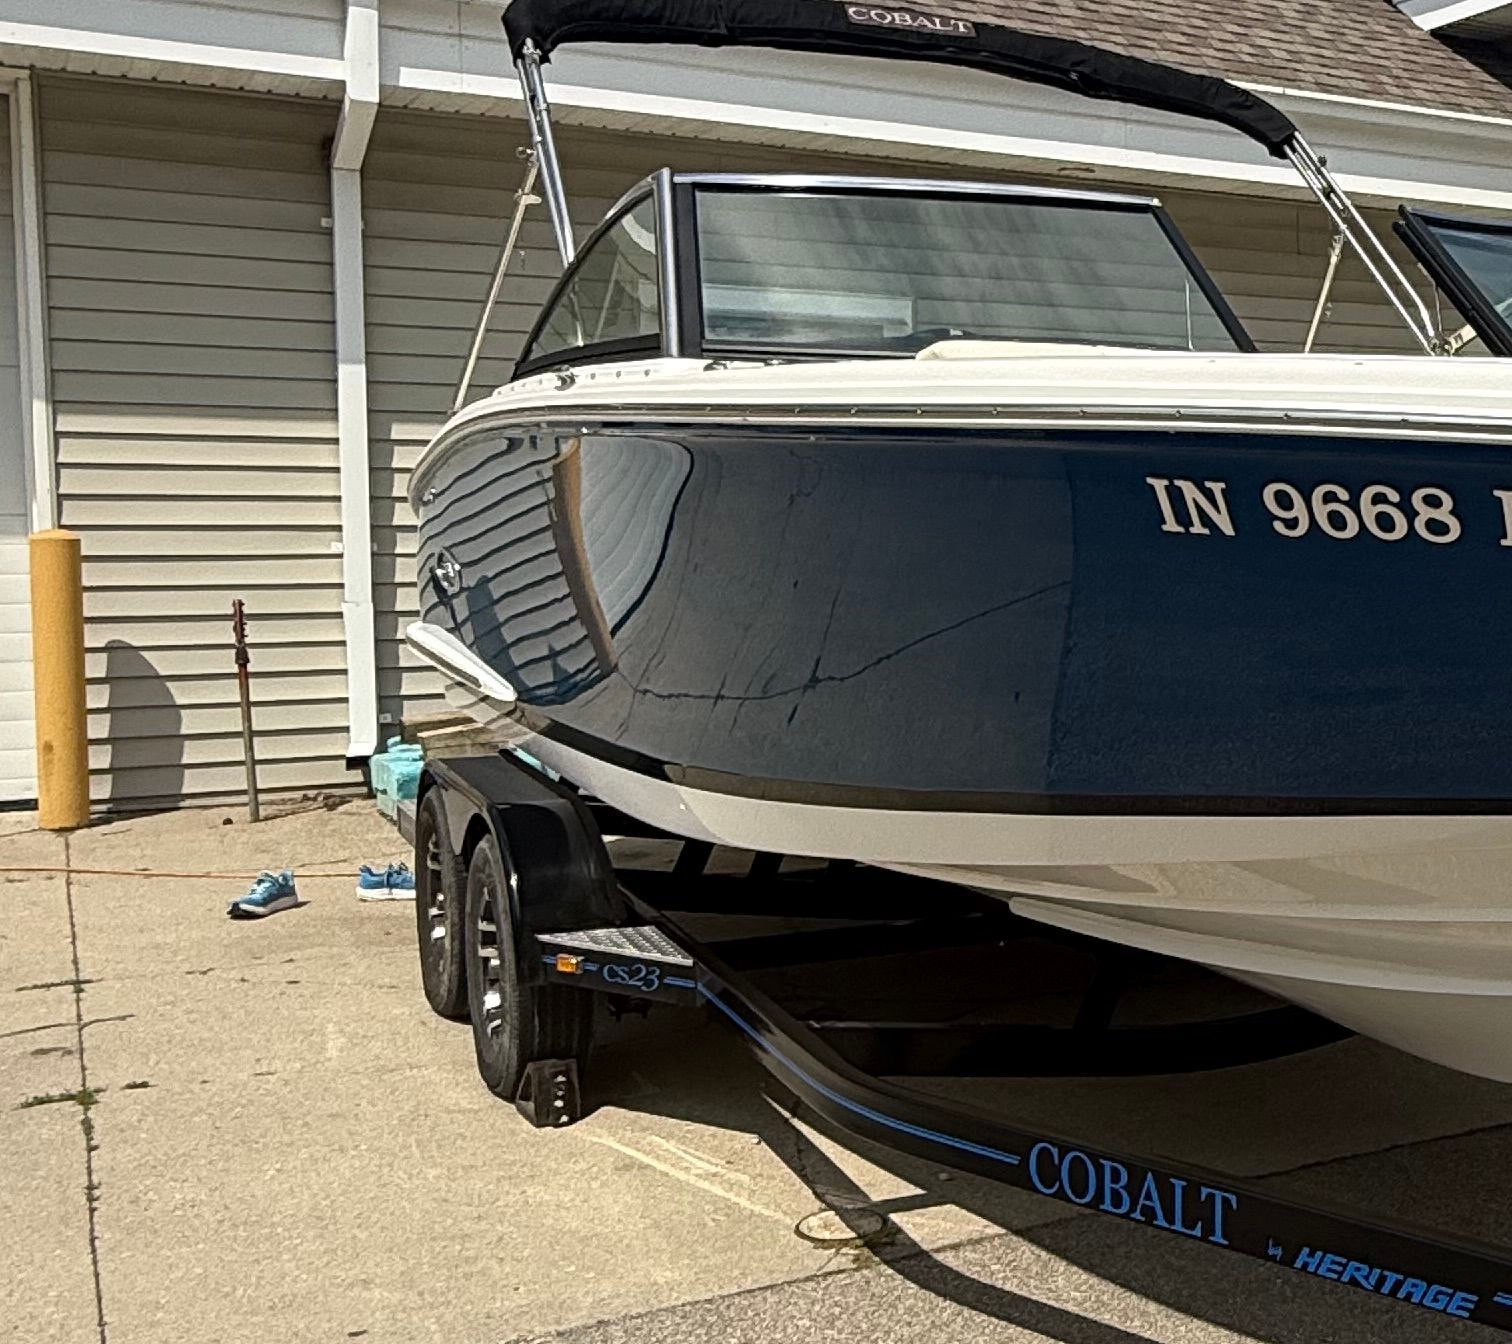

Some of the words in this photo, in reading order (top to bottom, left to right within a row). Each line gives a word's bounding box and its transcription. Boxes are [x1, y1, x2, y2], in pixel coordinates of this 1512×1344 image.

[848, 7, 972, 32] COBALT
[1146, 477, 1236, 537] IN
[1262, 482, 1462, 544] 9668
[1028, 1142, 1237, 1245] COBALT
[1294, 1246, 1479, 1319] HERITAGE
